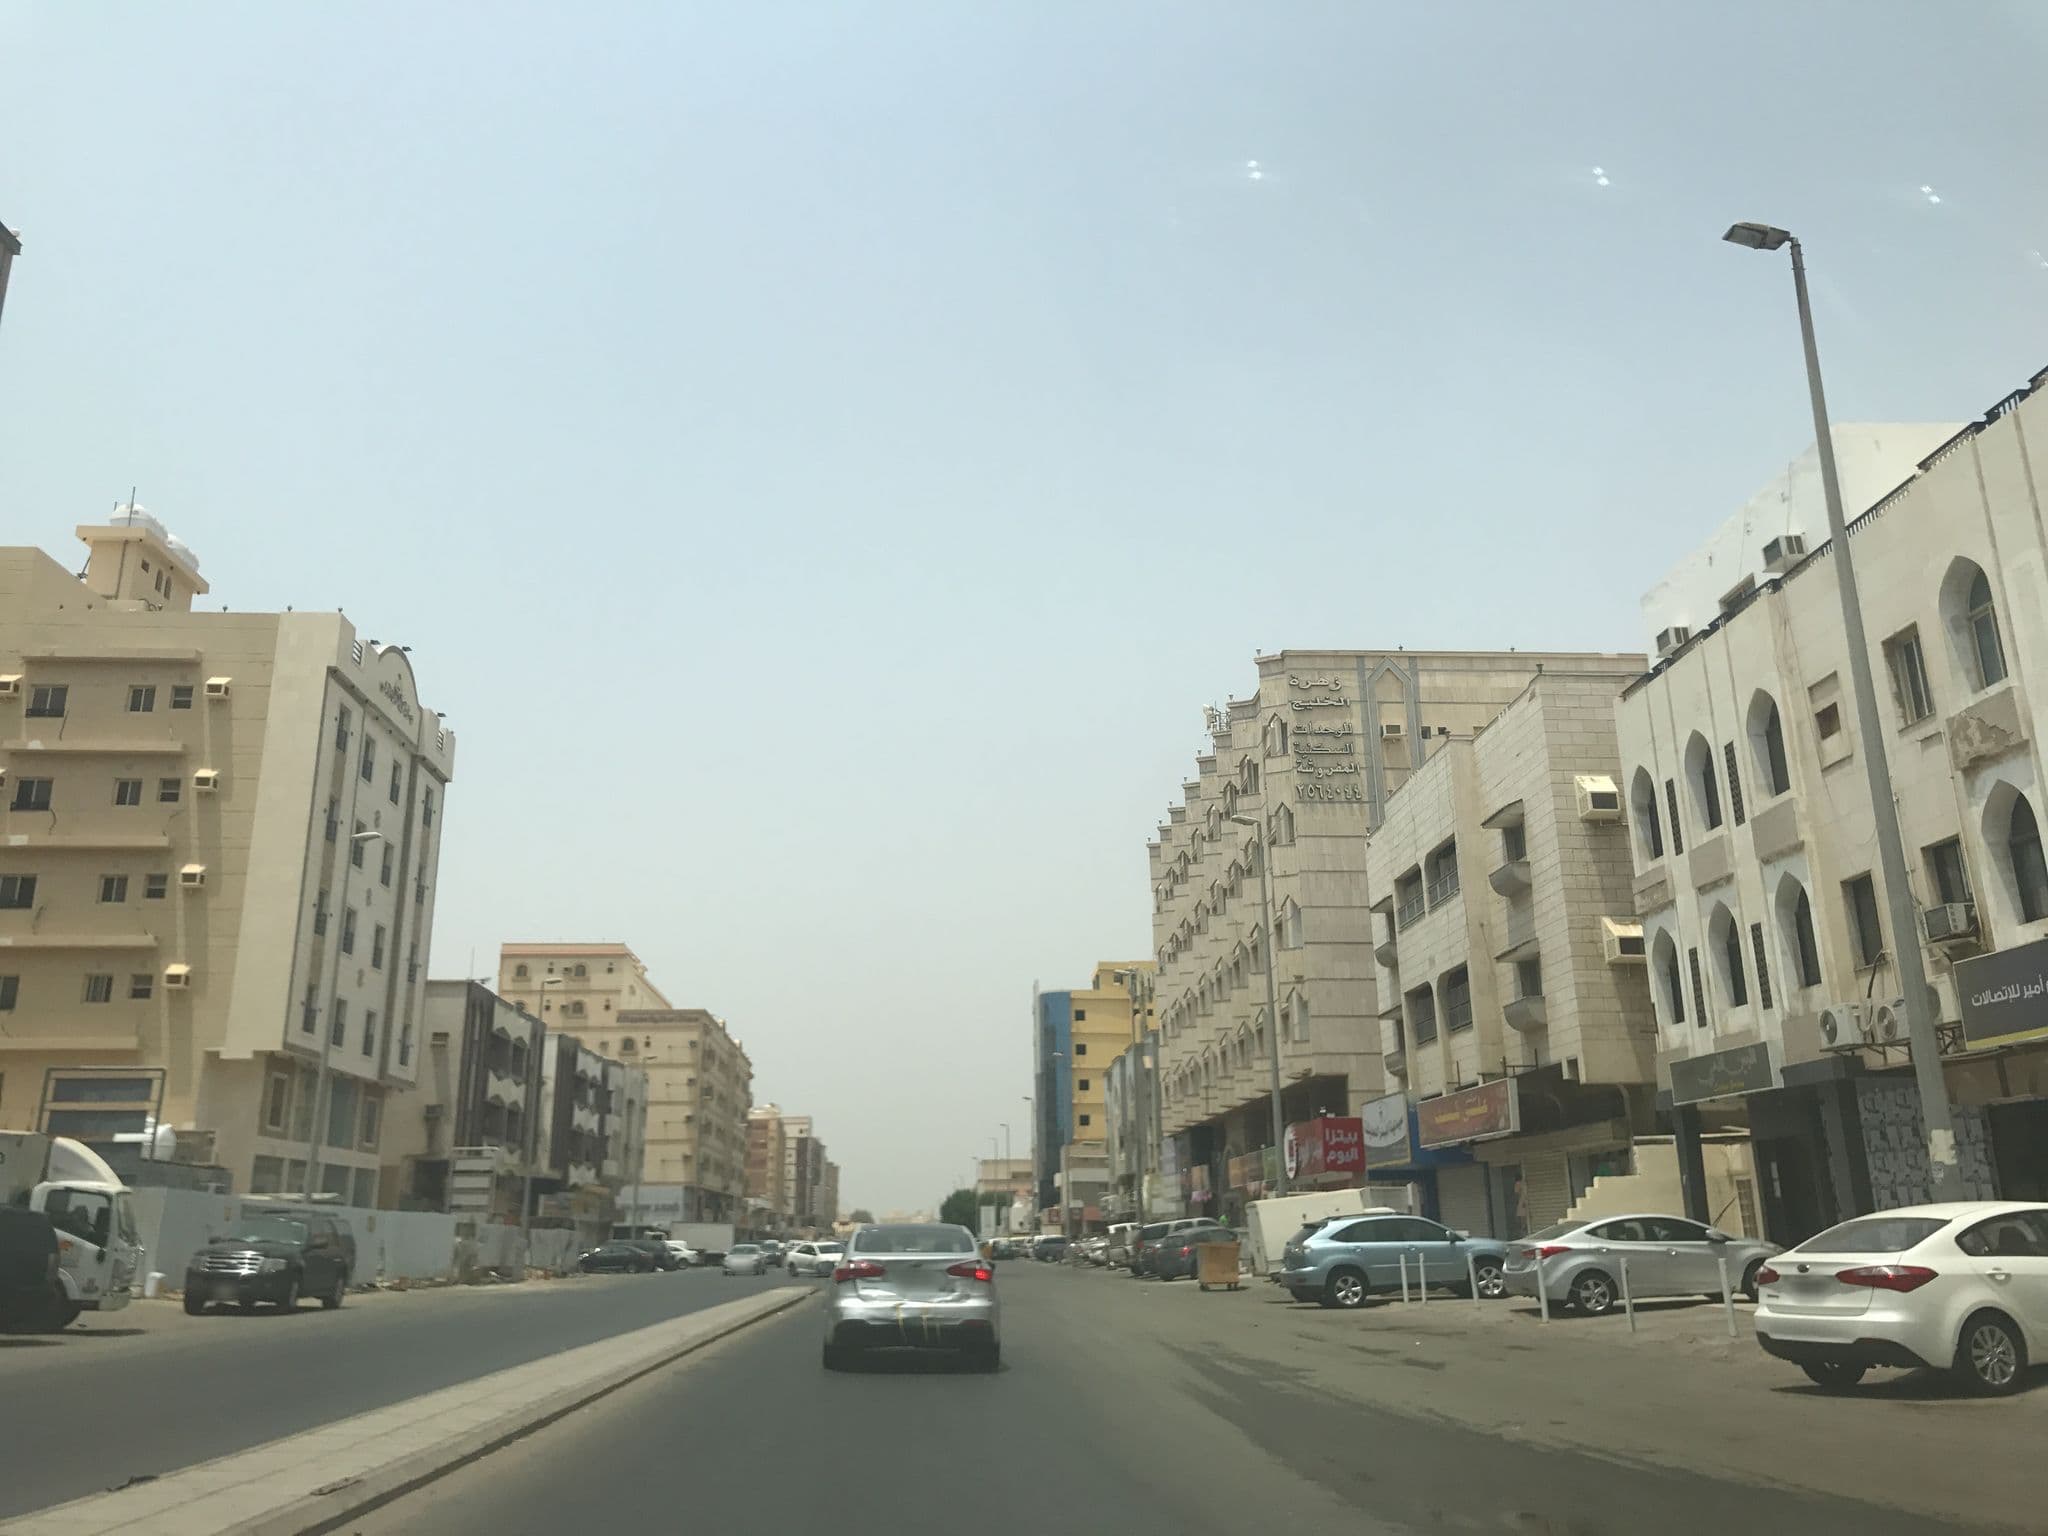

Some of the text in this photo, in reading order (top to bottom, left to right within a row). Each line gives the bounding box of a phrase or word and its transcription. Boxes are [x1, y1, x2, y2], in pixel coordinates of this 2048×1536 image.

[1289, 674, 1343, 691] زهرة
[1291, 696, 1351, 711] الخليج
[1292, 722, 1353, 738] للوحدات
[1294, 742, 1355, 758] السكنية
[1296, 759, 1361, 778] المفروشة
[2023, 974, 2044, 999] أمير
[1325, 1128, 1358, 1145] بيتزا
[1327, 1147, 1360, 1164] اليوم
